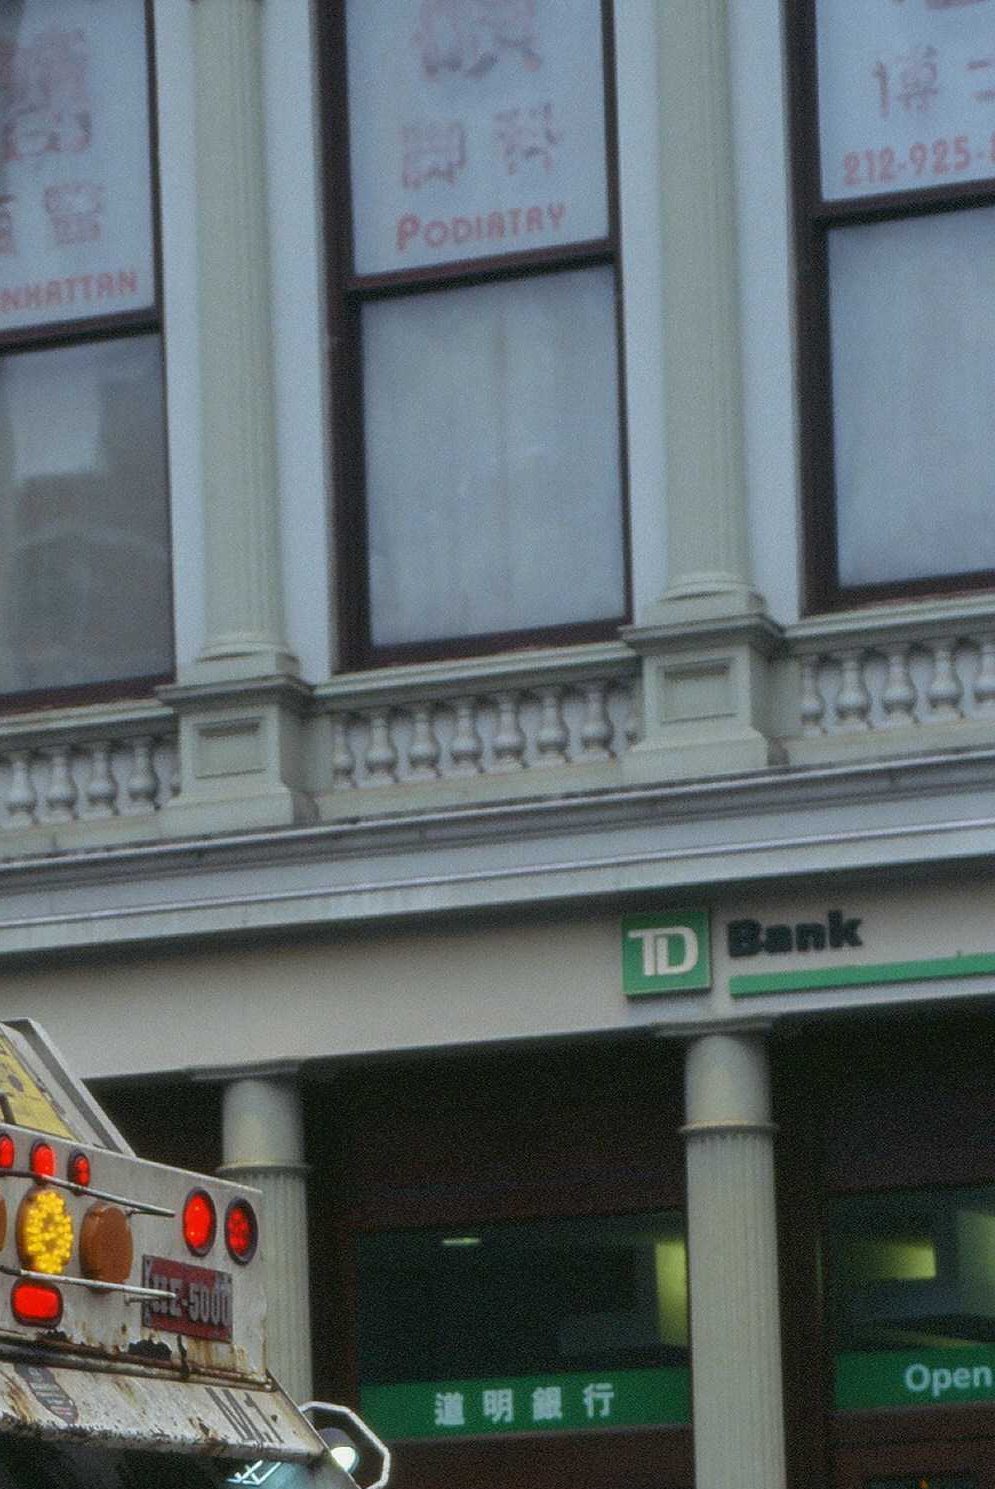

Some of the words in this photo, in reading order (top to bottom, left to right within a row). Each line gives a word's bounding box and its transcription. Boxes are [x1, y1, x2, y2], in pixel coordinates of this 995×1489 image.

[843, 132, 995, 187] 212-925-
[628, 925, 700, 977] TD
[727, 909, 864, 959] Bank
[905, 1362, 993, 1398] Open
